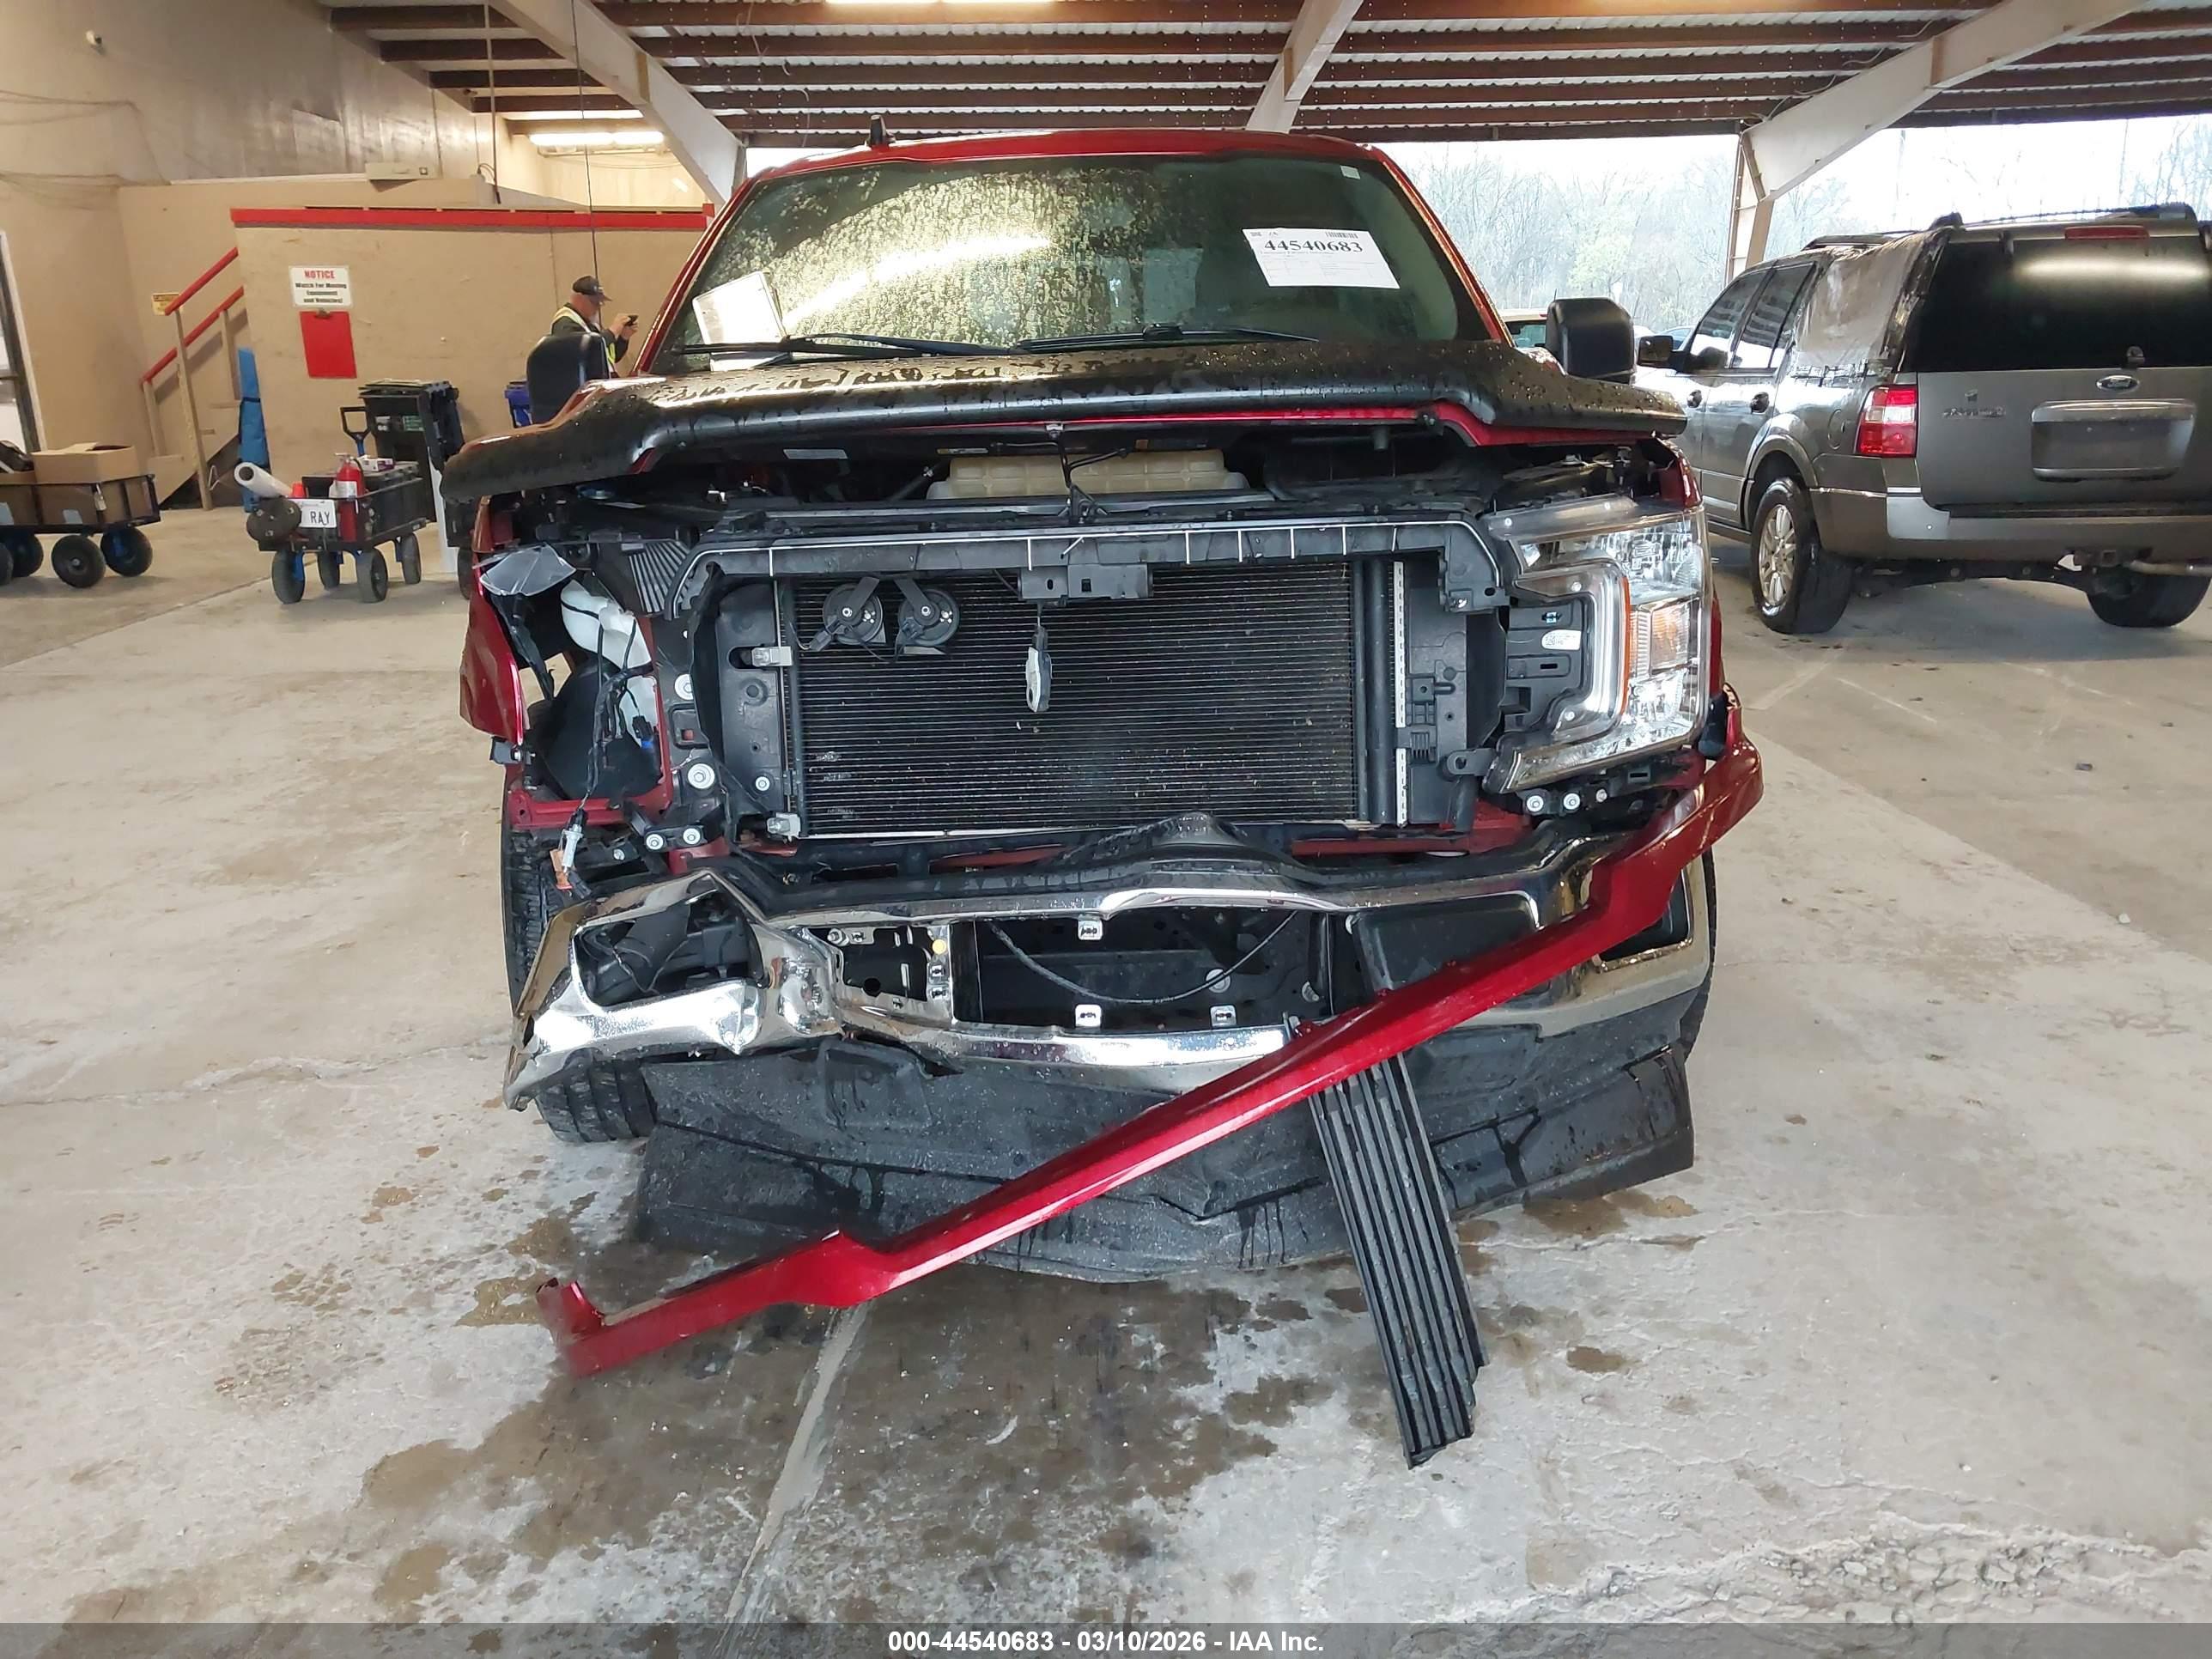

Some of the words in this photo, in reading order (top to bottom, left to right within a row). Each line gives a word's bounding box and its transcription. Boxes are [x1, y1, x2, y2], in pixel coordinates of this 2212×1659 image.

[1264, 240, 1364, 252] 44540683
[304, 270, 335, 279] NOTICE
[310, 510, 331, 524] RAY
